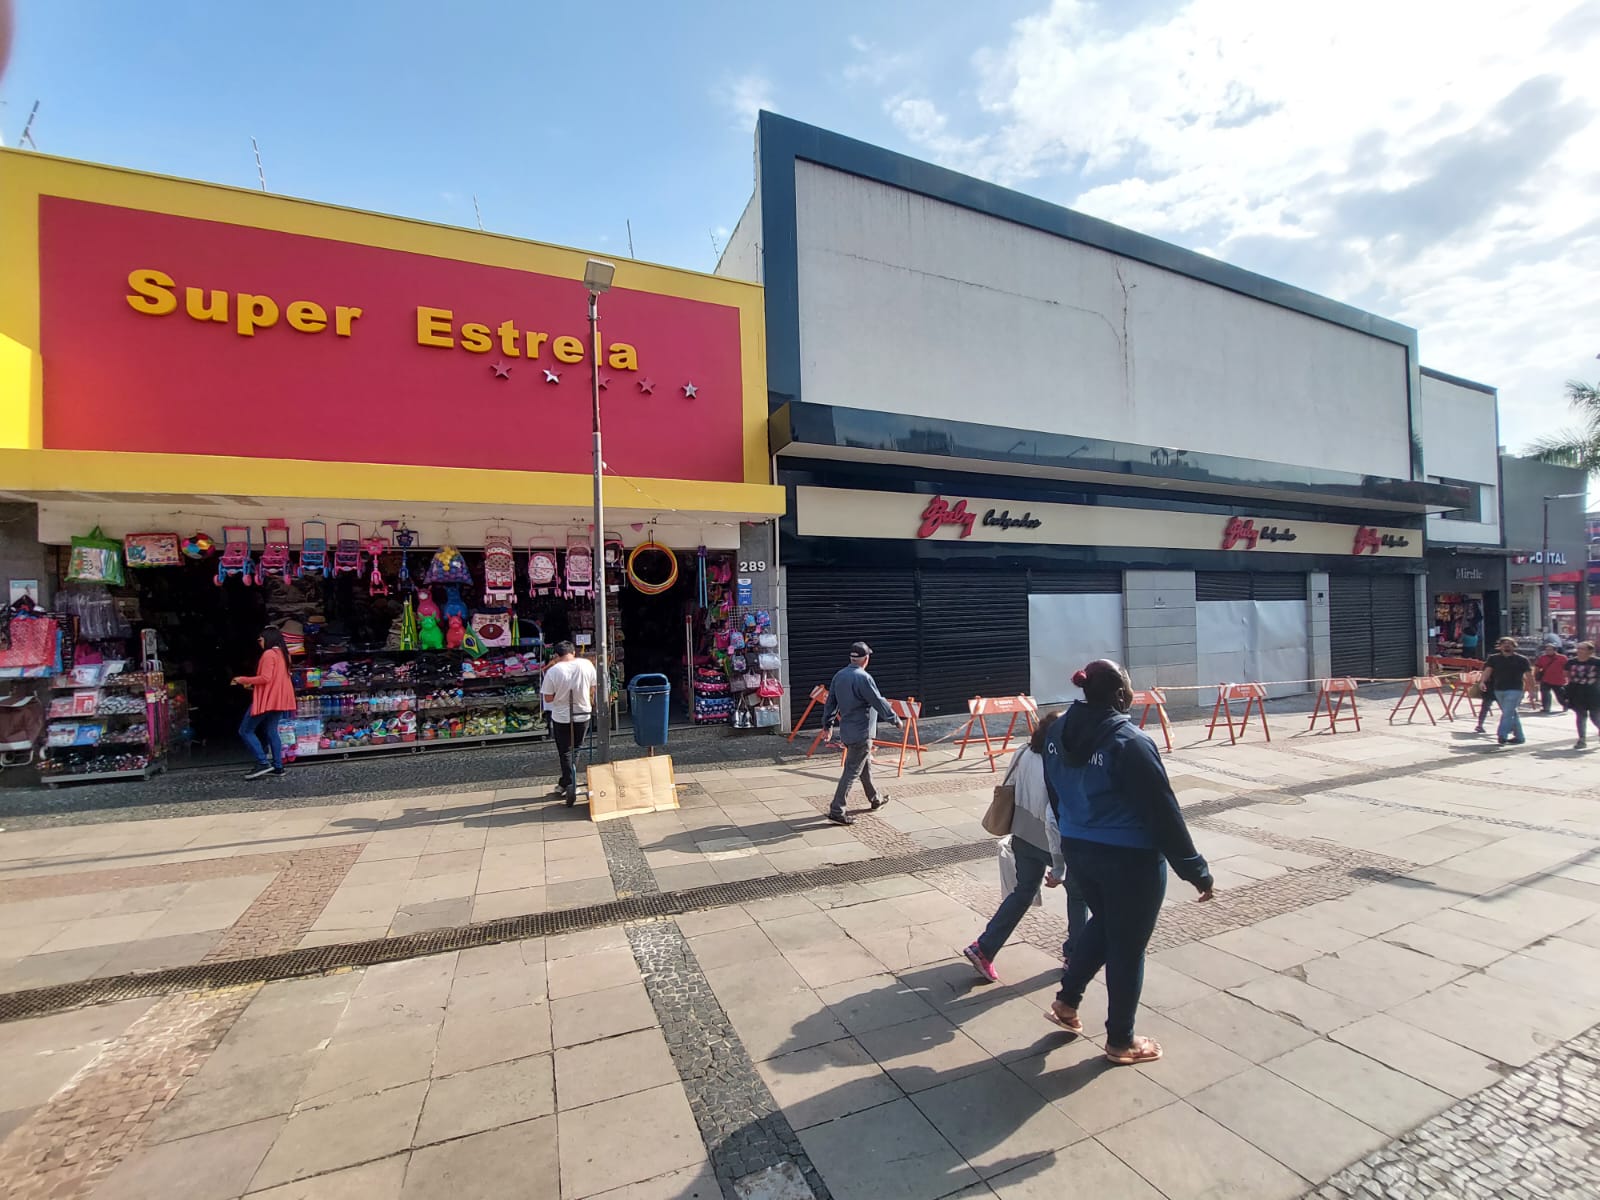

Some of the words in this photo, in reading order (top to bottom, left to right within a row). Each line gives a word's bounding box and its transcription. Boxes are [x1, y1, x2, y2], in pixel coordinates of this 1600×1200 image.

[126, 268, 364, 337] Super
[416, 305, 640, 372] Estrela
[739, 560, 766, 573] 289
